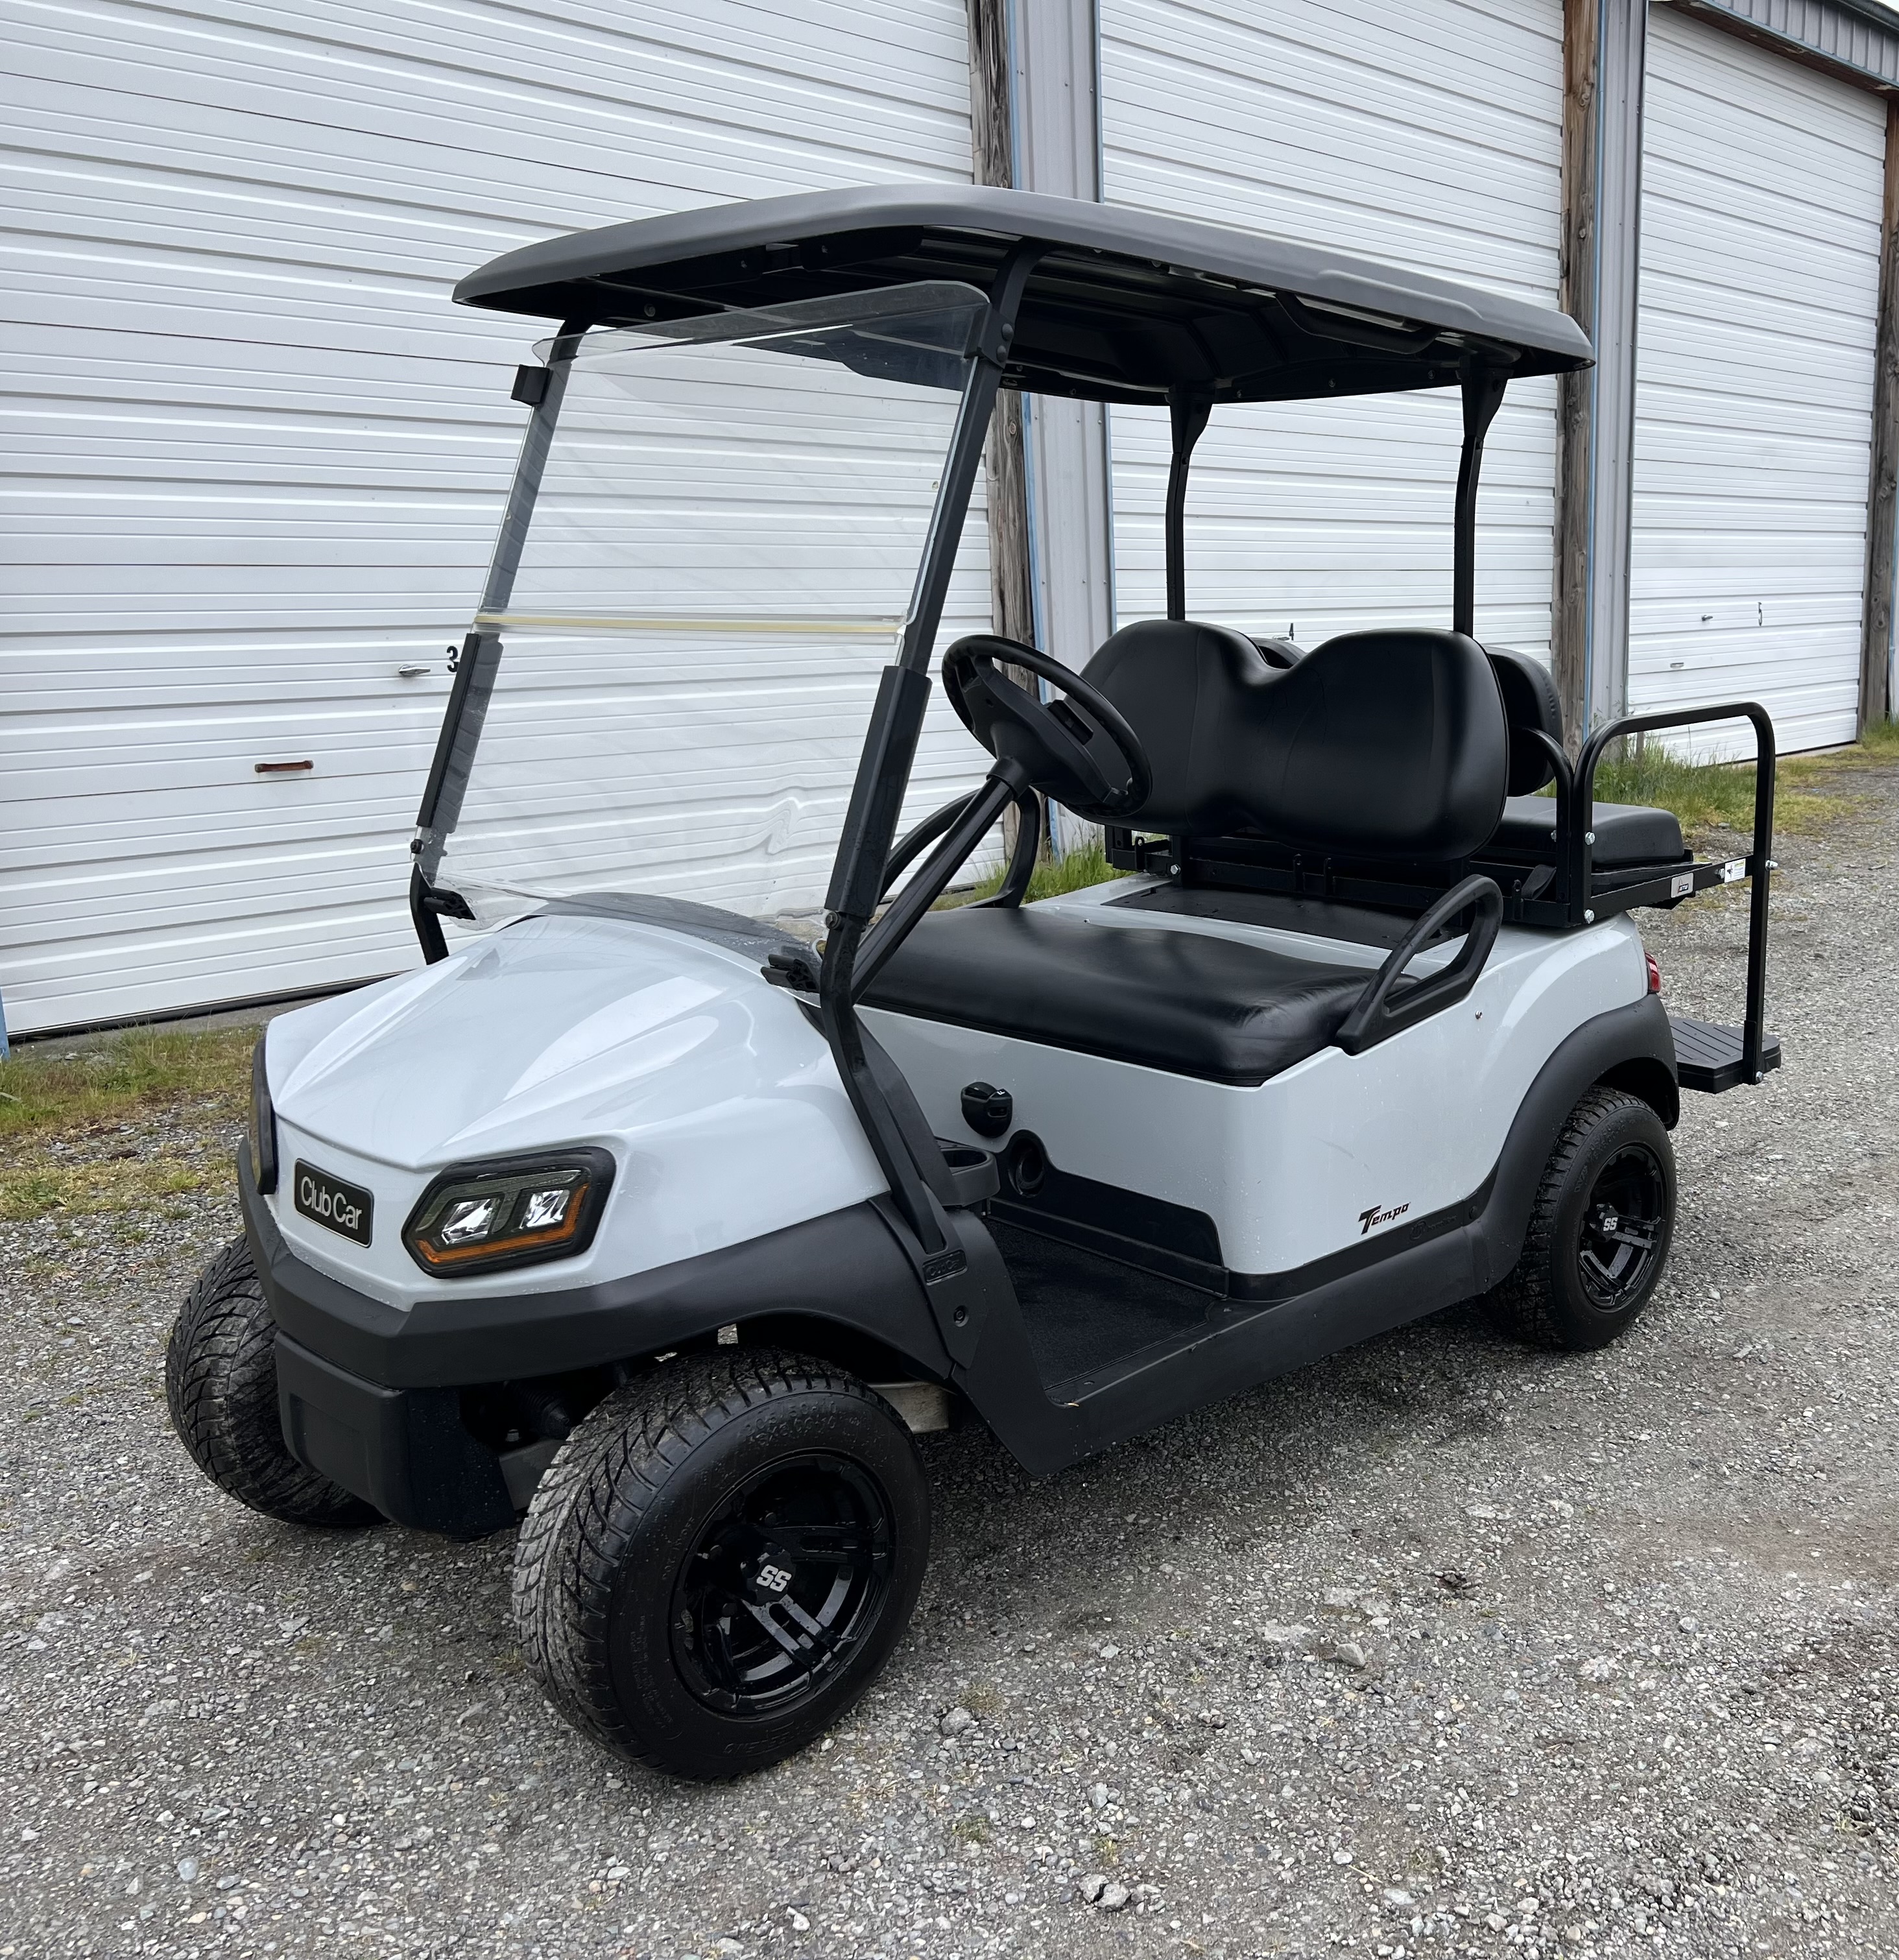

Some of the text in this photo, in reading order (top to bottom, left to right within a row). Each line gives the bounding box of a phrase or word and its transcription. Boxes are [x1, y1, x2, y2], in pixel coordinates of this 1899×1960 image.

[1758, 601, 1763, 627] 5
[446, 645, 460, 673] 3
[301, 1176, 363, 1230] Club Car
[1357, 1202, 1411, 1235] Tempo
[1603, 1217, 1618, 1231] SS
[756, 1564, 792, 1592] SS
